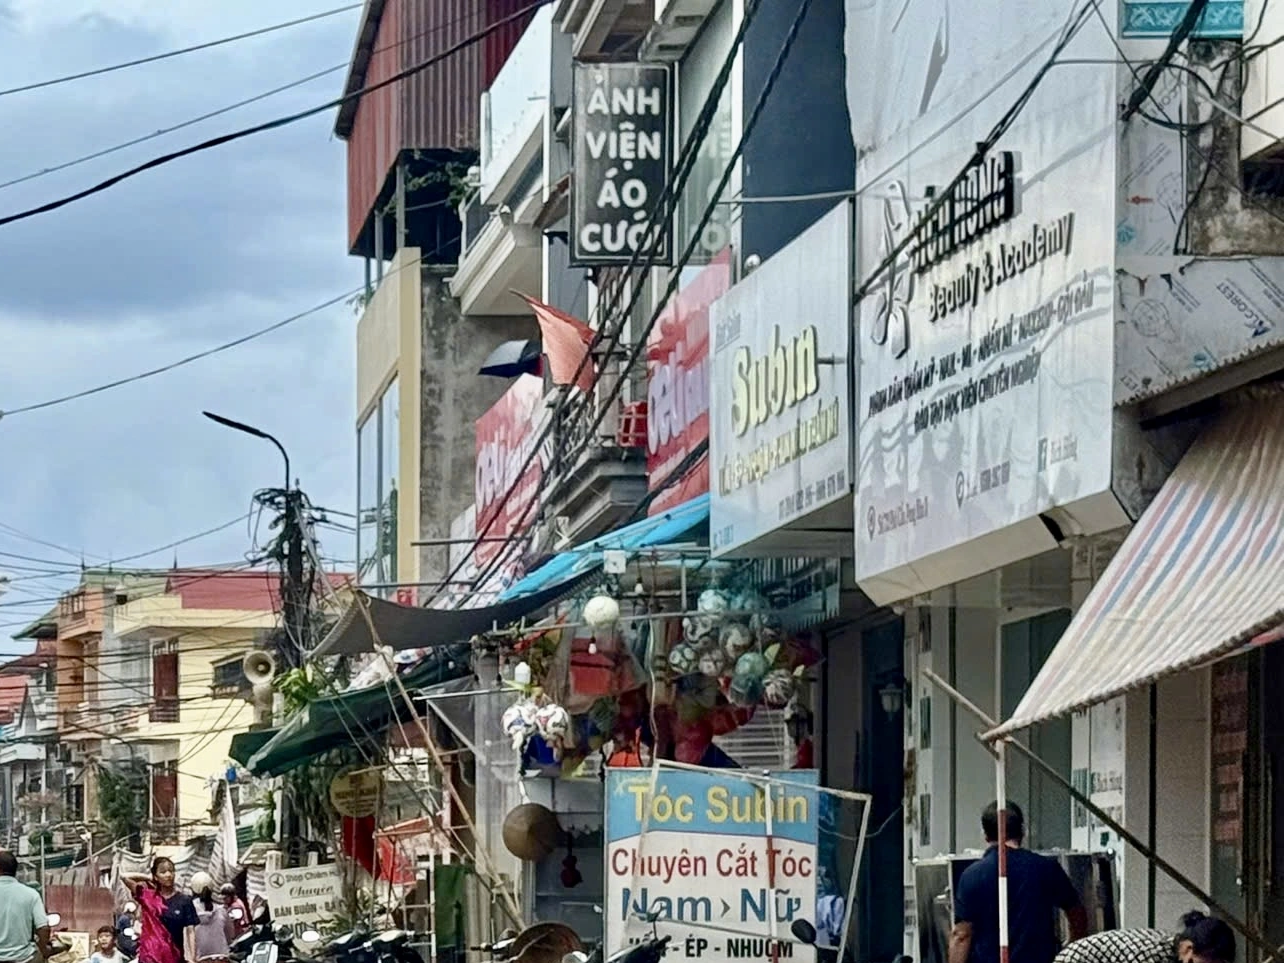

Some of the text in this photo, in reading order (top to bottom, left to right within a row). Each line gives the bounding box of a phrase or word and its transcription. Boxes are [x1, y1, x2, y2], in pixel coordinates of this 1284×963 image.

[587, 72, 660, 115] ẢNH
[586, 121, 661, 170] VIỆN
[596, 167, 648, 208] ÁO
[580, 209, 662, 252] CƯỚI
[929, 212, 1075, 322] Beauty & Academy
[731, 323, 818, 438] Subin
[628, 783, 809, 824] Tóc Subin
[612, 842, 812, 884] Chuyên Cắt Tóc
[622, 887, 802, 922] Nam Nữ
[685, 933, 708, 958] ÉP
[727, 938, 793, 962] NHUỘM
